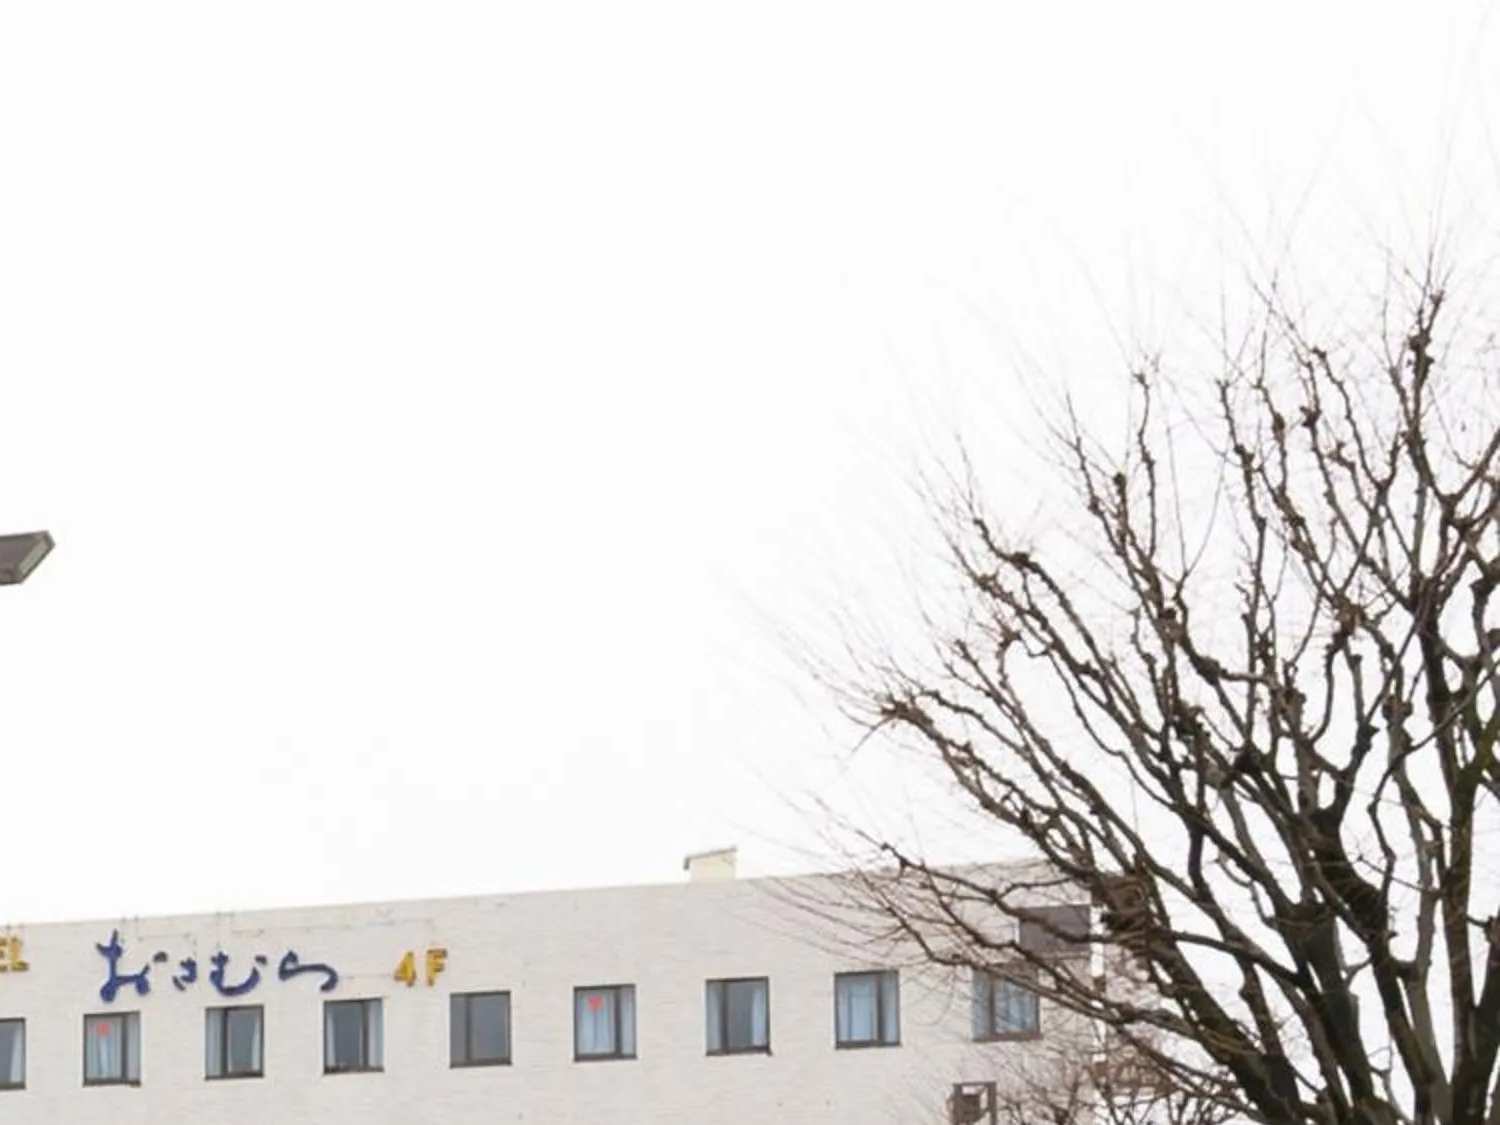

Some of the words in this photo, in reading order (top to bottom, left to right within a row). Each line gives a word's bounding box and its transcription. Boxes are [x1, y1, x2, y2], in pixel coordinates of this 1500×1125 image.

[95, 929, 338, 1002] おさむら
[393, 947, 449, 988] 4F
